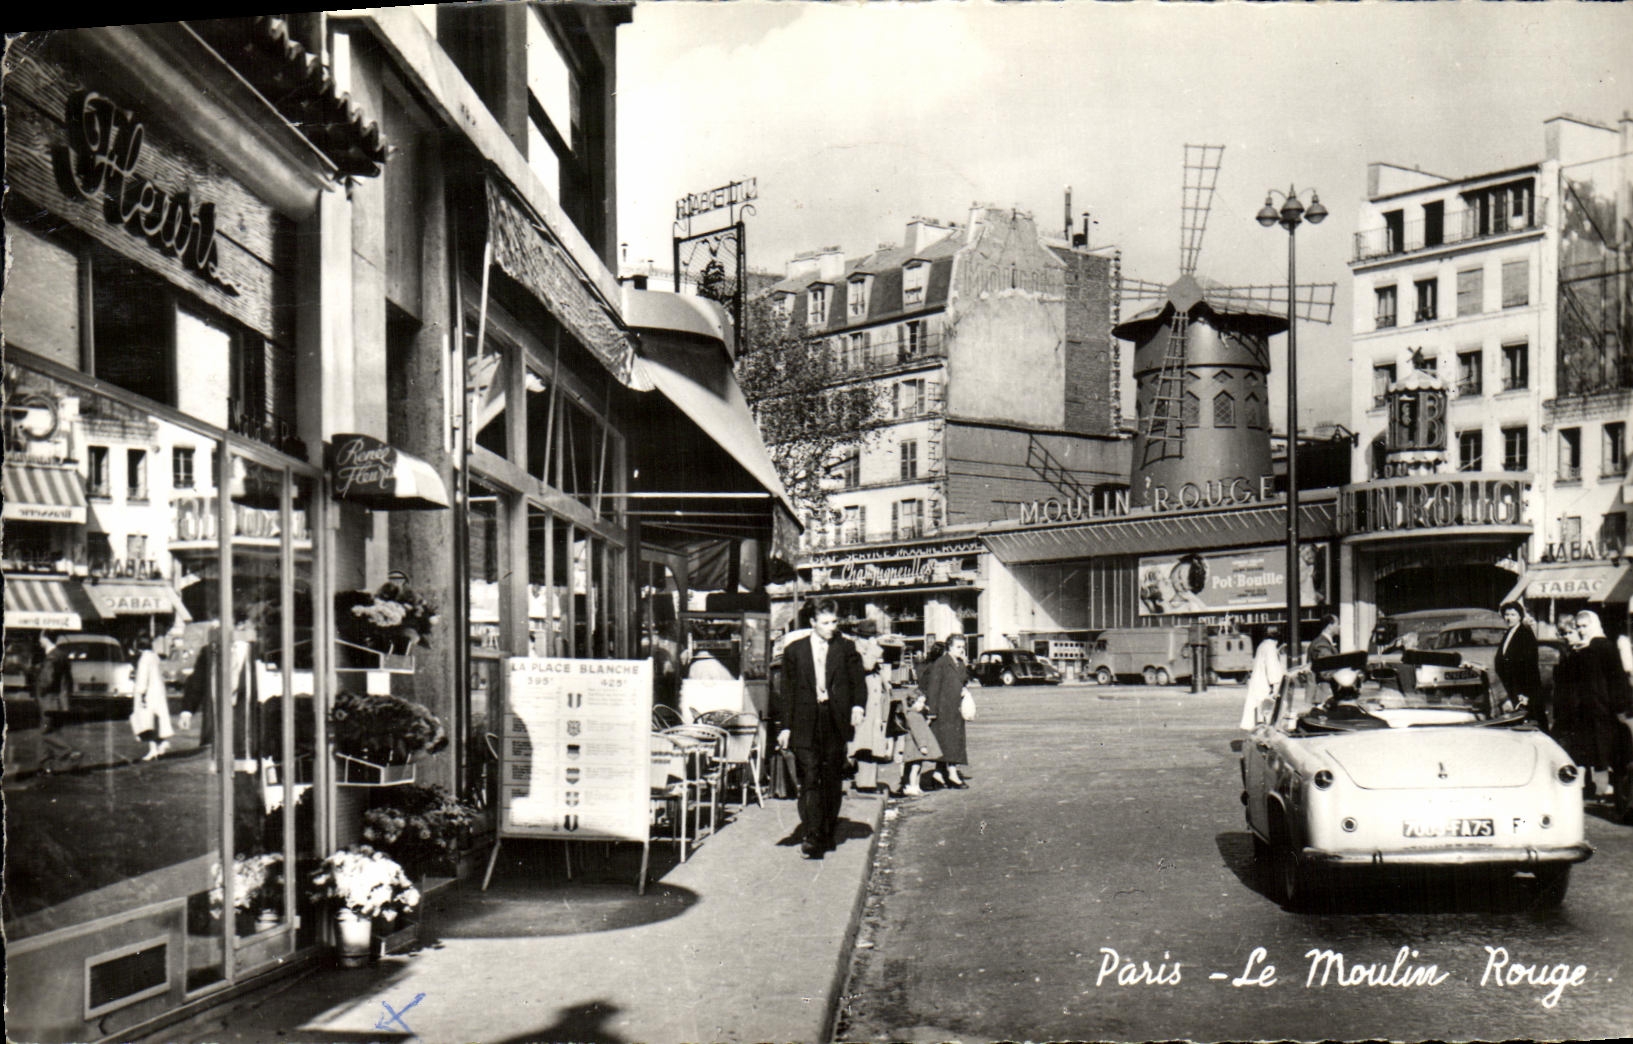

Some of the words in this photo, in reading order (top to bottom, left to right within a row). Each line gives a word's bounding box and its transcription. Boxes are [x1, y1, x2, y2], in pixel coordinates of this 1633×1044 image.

[1019, 488, 1131, 525] MOULIN
[1154, 475, 1274, 512] ROUGE
[1537, 580, 1603, 593] TABAC
[511, 662, 526, 673] LA
[531, 663, 571, 673] PLACE
[579, 664, 640, 674] BLANCHE
